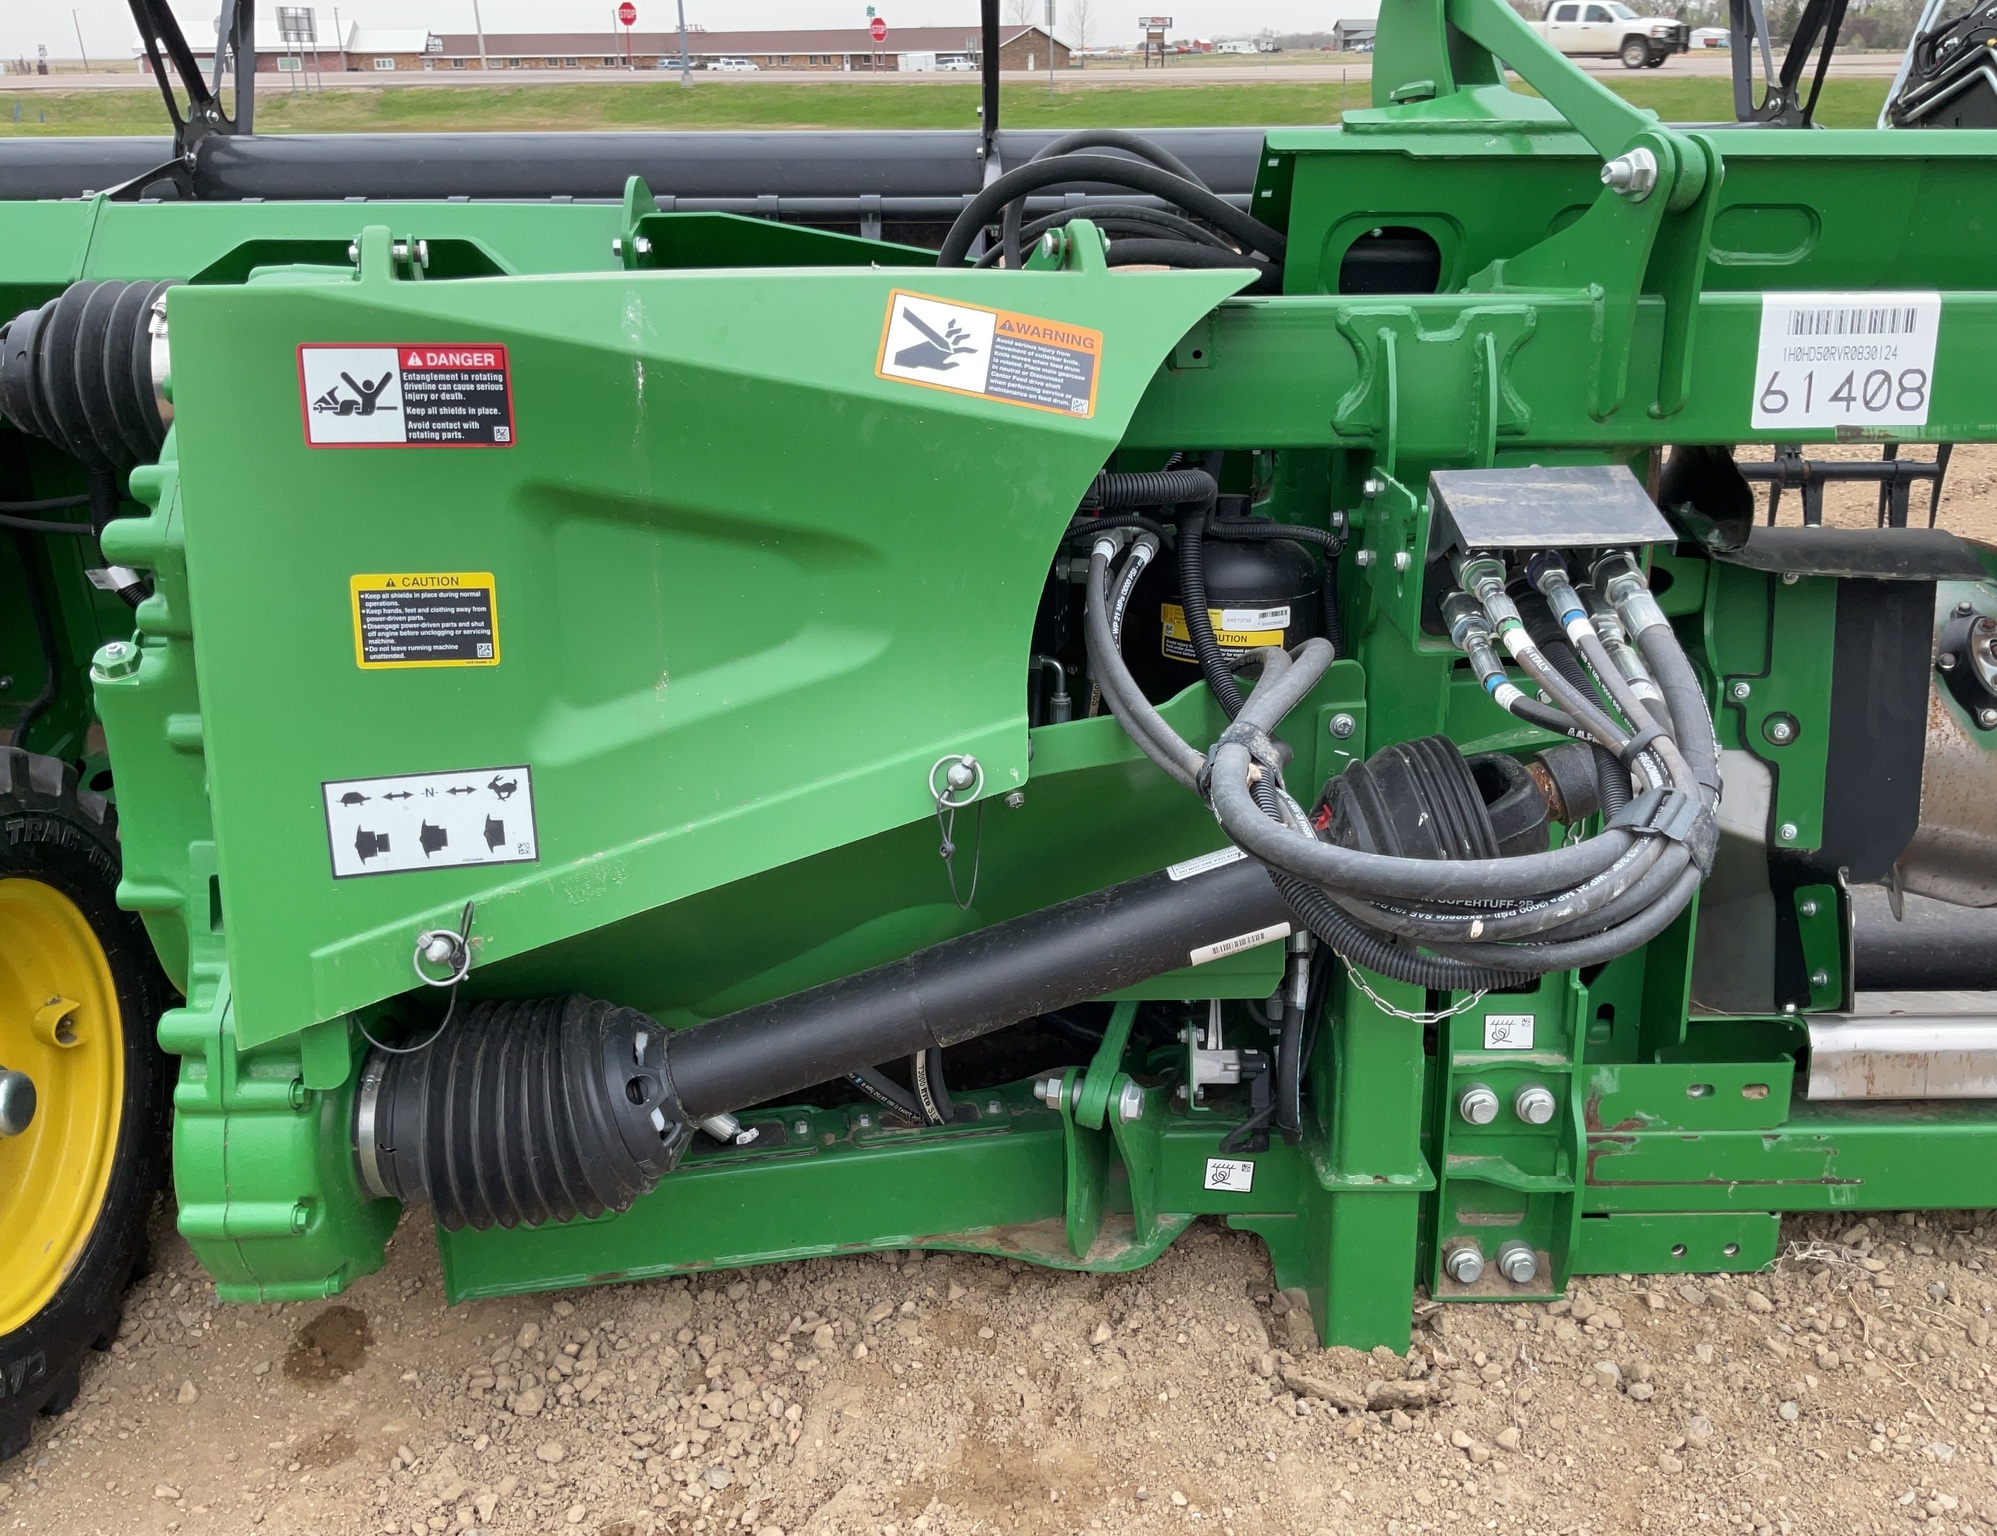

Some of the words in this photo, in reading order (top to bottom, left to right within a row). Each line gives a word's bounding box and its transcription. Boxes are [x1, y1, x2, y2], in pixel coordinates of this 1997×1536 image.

[619, 10, 636, 18] STOP
[871, 26, 886, 34] STOP
[996, 337, 1013, 345] Avoid
[1014, 341, 1036, 350] serious
[1014, 322, 1095, 349] WARNING
[426, 353, 495, 366] DANGER
[994, 344, 1026, 354] movement
[1034, 352, 1062, 362] cutterbar
[1063, 358, 1080, 366] knife.
[994, 350, 1010, 358] Knife
[1010, 354, 1031, 362] moves
[1031, 358, 1048, 366] when
[403, 373, 458, 382] Entanglement
[471, 373, 503, 382] rotating
[990, 371, 1011, 379] Center
[999, 359, 1023, 368] rotated.
[1023, 363, 1041, 371] Place
[1041, 367, 1057, 375] main
[1057, 371, 1085, 381] gearcase
[999, 365, 1020, 374] neutral
[1029, 372, 1064, 383] Disconnect
[405, 392, 428, 401] injury
[440, 392, 465, 400] death.
[988, 385, 1027, 397] maintenance
[1052, 398, 1070, 406] drum.
[1007, 381, 1041, 393] performing
[1041, 389, 1064, 397] service
[1760, 369, 1926, 413] 61408
[407, 407, 426, 416] Keep
[428, 407, 437, 415] all
[439, 407, 466, 415] shields
[468, 407, 476, 415] in
[478, 407, 501, 416] place.
[409, 431, 440, 440] rotating
[442, 431, 465, 440] parts.
[402, 577, 458, 587] CAUTION
[1115, 595, 1126, 611] MPa
[1112, 611, 1122, 621] 21
[1110, 621, 1121, 635] WP
[1216, 635, 1247, 643] UTION
[1528, 651, 1551, 674] ITALY
[6, 818, 80, 851] TRAC
[1574, 880, 1590, 896] 21
[1588, 870, 1607, 890] WP
[920, 1087, 931, 1106] RYCO
